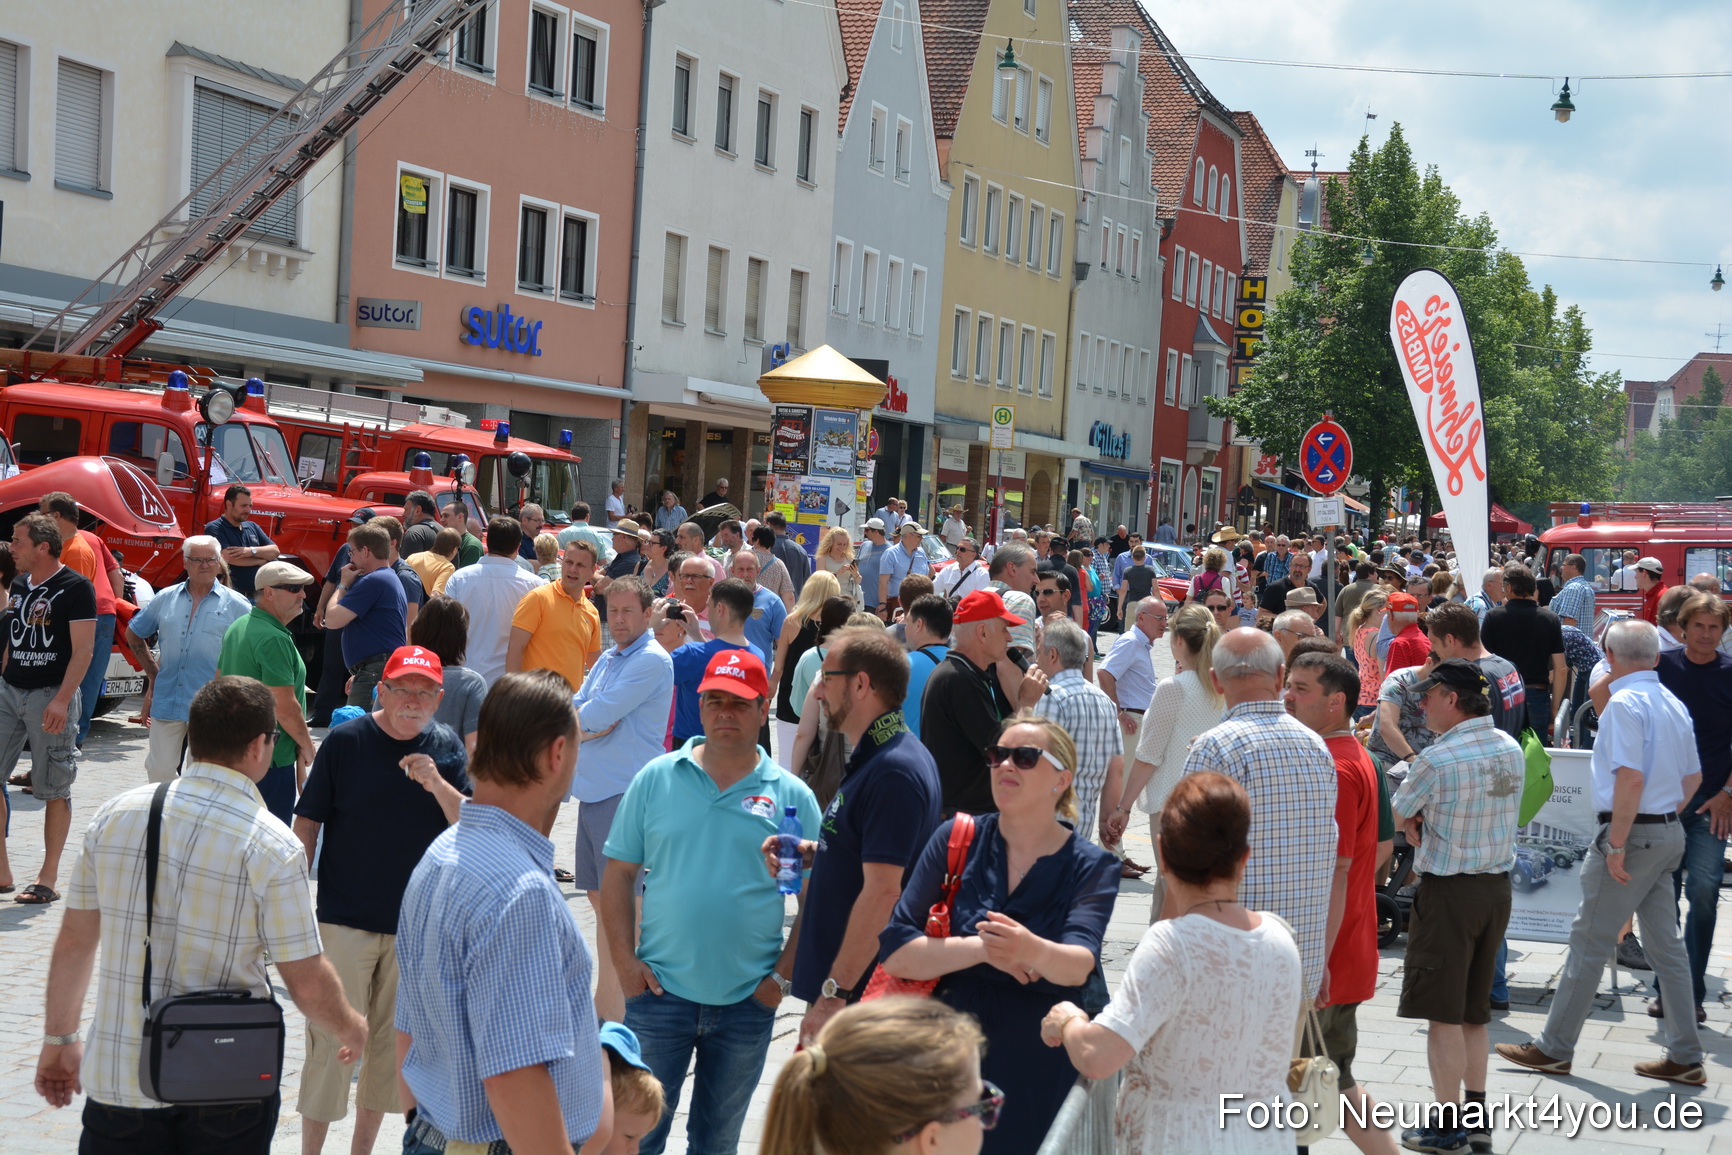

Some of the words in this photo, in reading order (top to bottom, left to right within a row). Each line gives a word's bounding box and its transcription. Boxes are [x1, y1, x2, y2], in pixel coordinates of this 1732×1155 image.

[358, 303, 414, 324] sutor.
[467, 303, 543, 357] sutor.
[1237, 279, 1266, 386] HOTE
[999, 411, 1008, 421] H
[107, 536, 123, 545] STADT
[124, 538, 154, 548] NEUMARKT
[12, 650, 58, 661] MUCHMORE
[403, 657, 431, 668] DEKRA
[715, 666, 746, 679] DEKRA
[105, 681, 120, 694] ERH
[134, 680, 143, 692] 25
[1554, 786, 1582, 795] RISCHE
